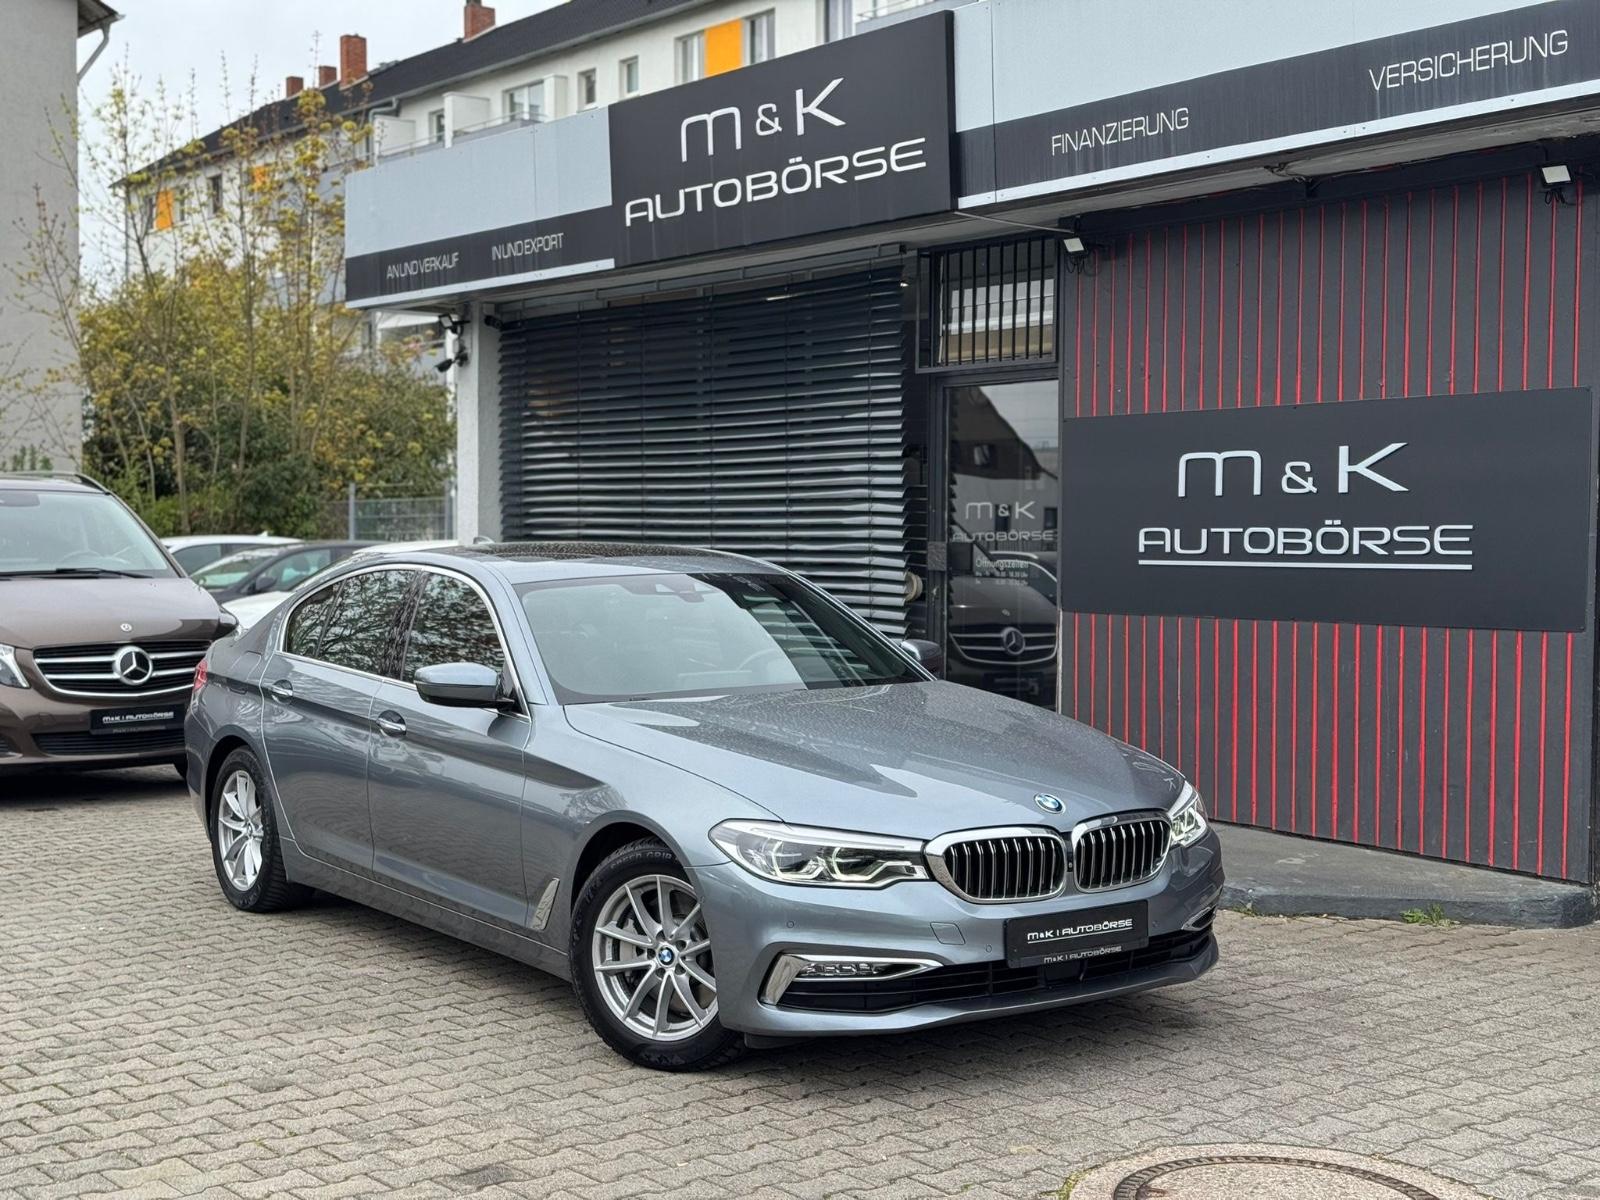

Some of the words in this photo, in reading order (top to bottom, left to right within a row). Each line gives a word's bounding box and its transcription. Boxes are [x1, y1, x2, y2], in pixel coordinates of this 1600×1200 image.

[1369, 29, 1568, 91] VERSICHERUNG
[680, 106, 742, 162] M
[755, 103, 782, 136] &
[795, 77, 846, 136] K
[1052, 106, 1189, 156] FINANZIERUNG
[625, 137, 927, 227] AUTOBÖRSE
[524, 232, 564, 254] EXPORT
[386, 264, 399, 279] AN
[419, 252, 460, 273] VERKAUF
[1178, 450, 1262, 497] M
[1281, 461, 1317, 494] &
[1338, 442, 1409, 493] K
[965, 502, 993, 519] M
[998, 504, 1010, 517] &
[1015, 501, 1036, 519] K
[952, 529, 1054, 541] AUTOBÖRSE
[1139, 519, 1473, 555] AUTOBÖRSE
[1062, 919, 1133, 936] AUTOBÖRSE
[1069, 946, 1122, 959] AUTOBÖRSE
